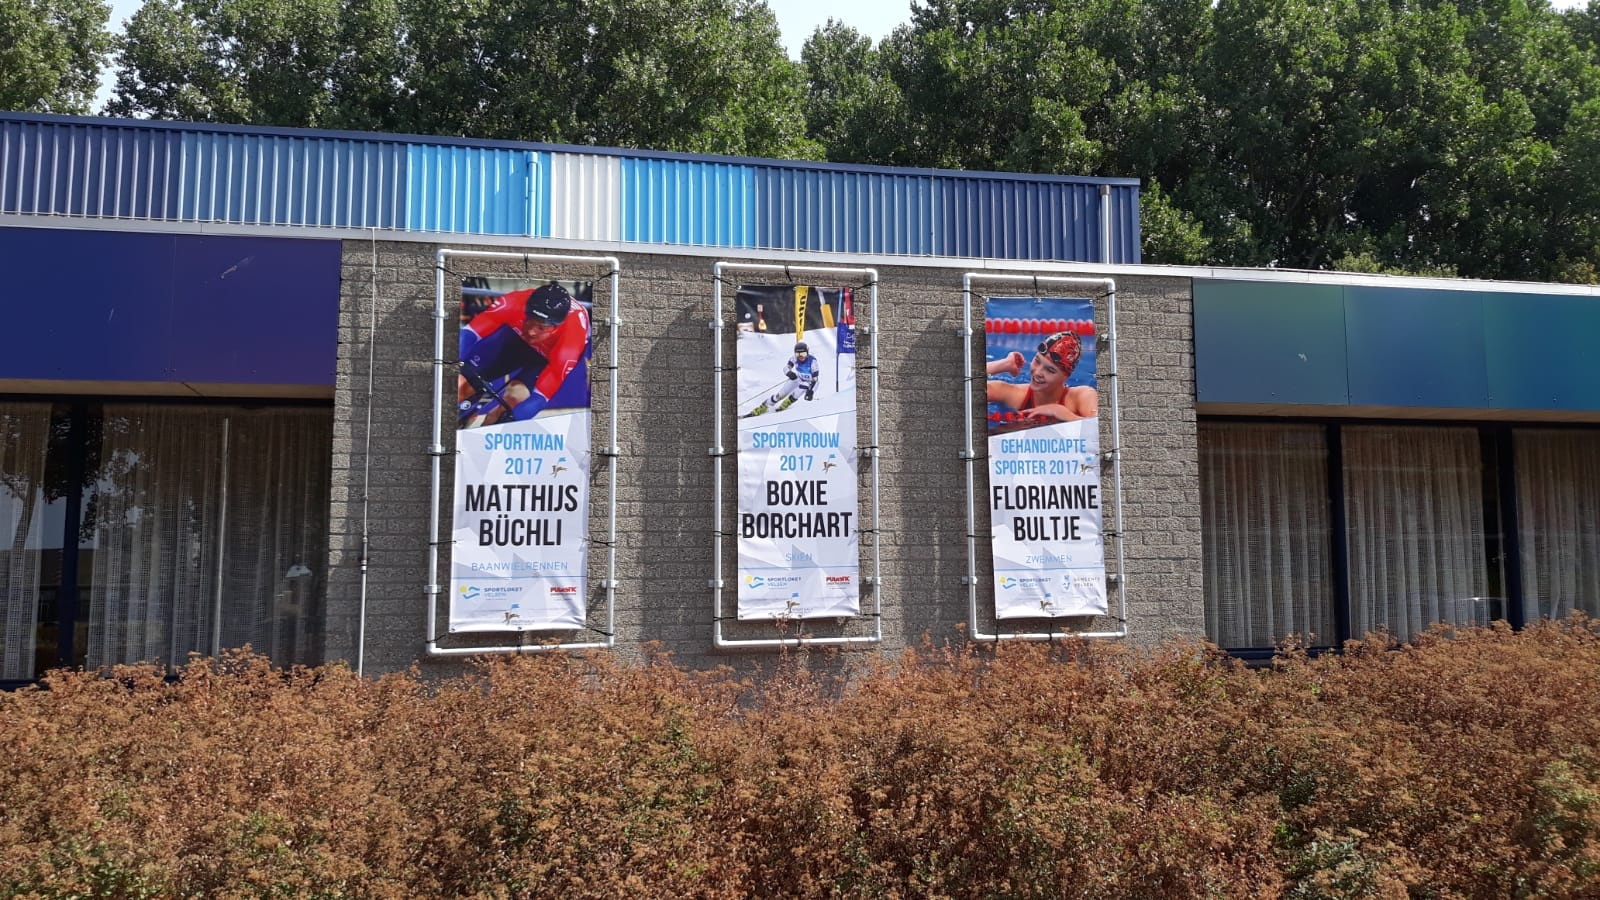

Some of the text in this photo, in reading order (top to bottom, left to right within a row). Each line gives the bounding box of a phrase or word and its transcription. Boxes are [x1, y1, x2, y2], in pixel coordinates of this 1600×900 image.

[485, 433, 564, 451] SPORTMAN
[752, 432, 840, 448] SPORTVROUW
[1001, 438, 1087, 454] GEHANDICAPTE
[504, 457, 543, 475] 2017
[780, 455, 813, 471] 2017
[995, 460, 1079, 475] SPORTER 2017
[465, 484, 578, 512] MATTHIJS
[766, 480, 828, 506] BOXIE
[993, 485, 1099, 510] FLORIANNE
[479, 513, 562, 546] BÜCHLI
[742, 512, 852, 538] BORCHART
[1013, 516, 1082, 541] BULTJE
[785, 552, 813, 562] SKIEN
[1025, 554, 1073, 564] ZWEMMEN
[471, 561, 568, 572] BAANWIELRENNEN
